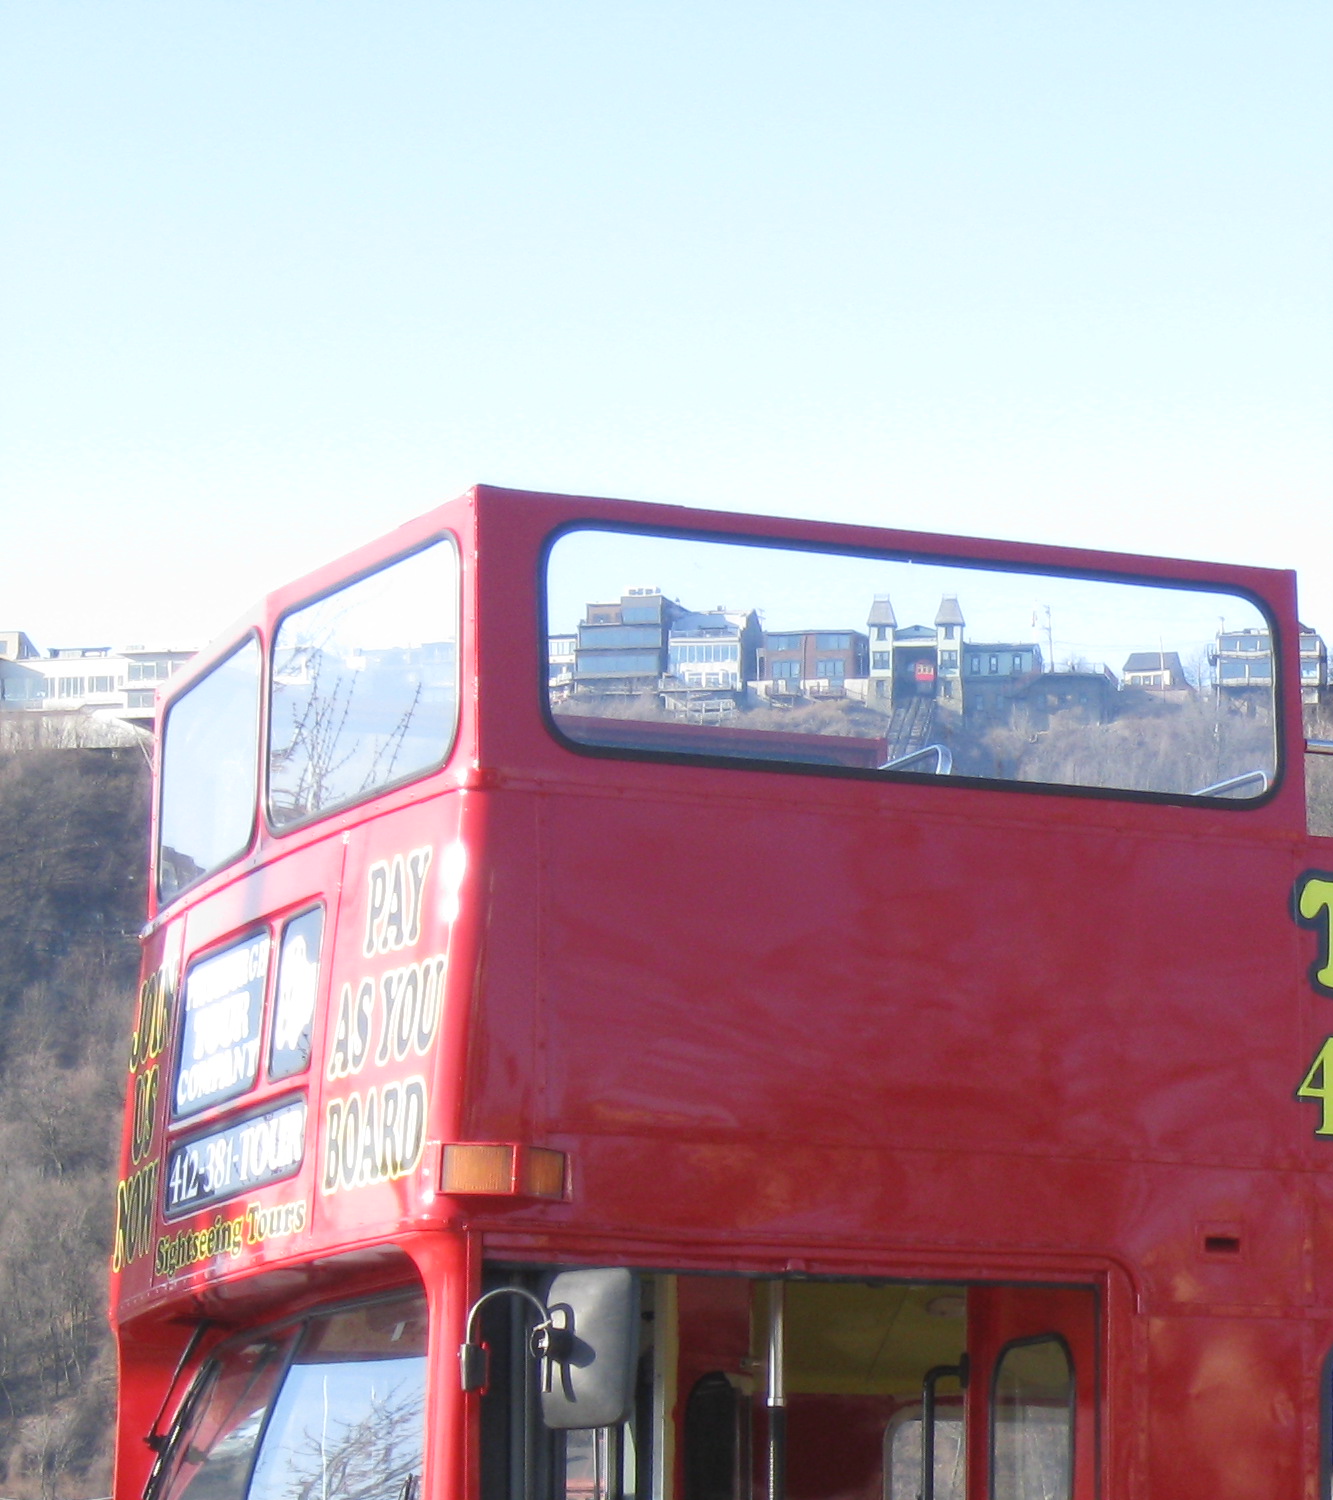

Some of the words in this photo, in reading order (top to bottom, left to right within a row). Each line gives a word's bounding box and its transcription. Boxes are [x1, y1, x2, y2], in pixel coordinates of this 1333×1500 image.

[363, 845, 433, 958] PAY
[327, 976, 375, 1081] AS
[375, 954, 447, 1066] YOU
[132, 1064, 160, 1165] US
[169, 1110, 304, 1204] 412-381-TOUR
[323, 1075, 428, 1195] BOARD
[112, 1158, 160, 1273] NOW
[155, 1214, 244, 1278] Sightseeing
[246, 1199, 306, 1245] Tours
